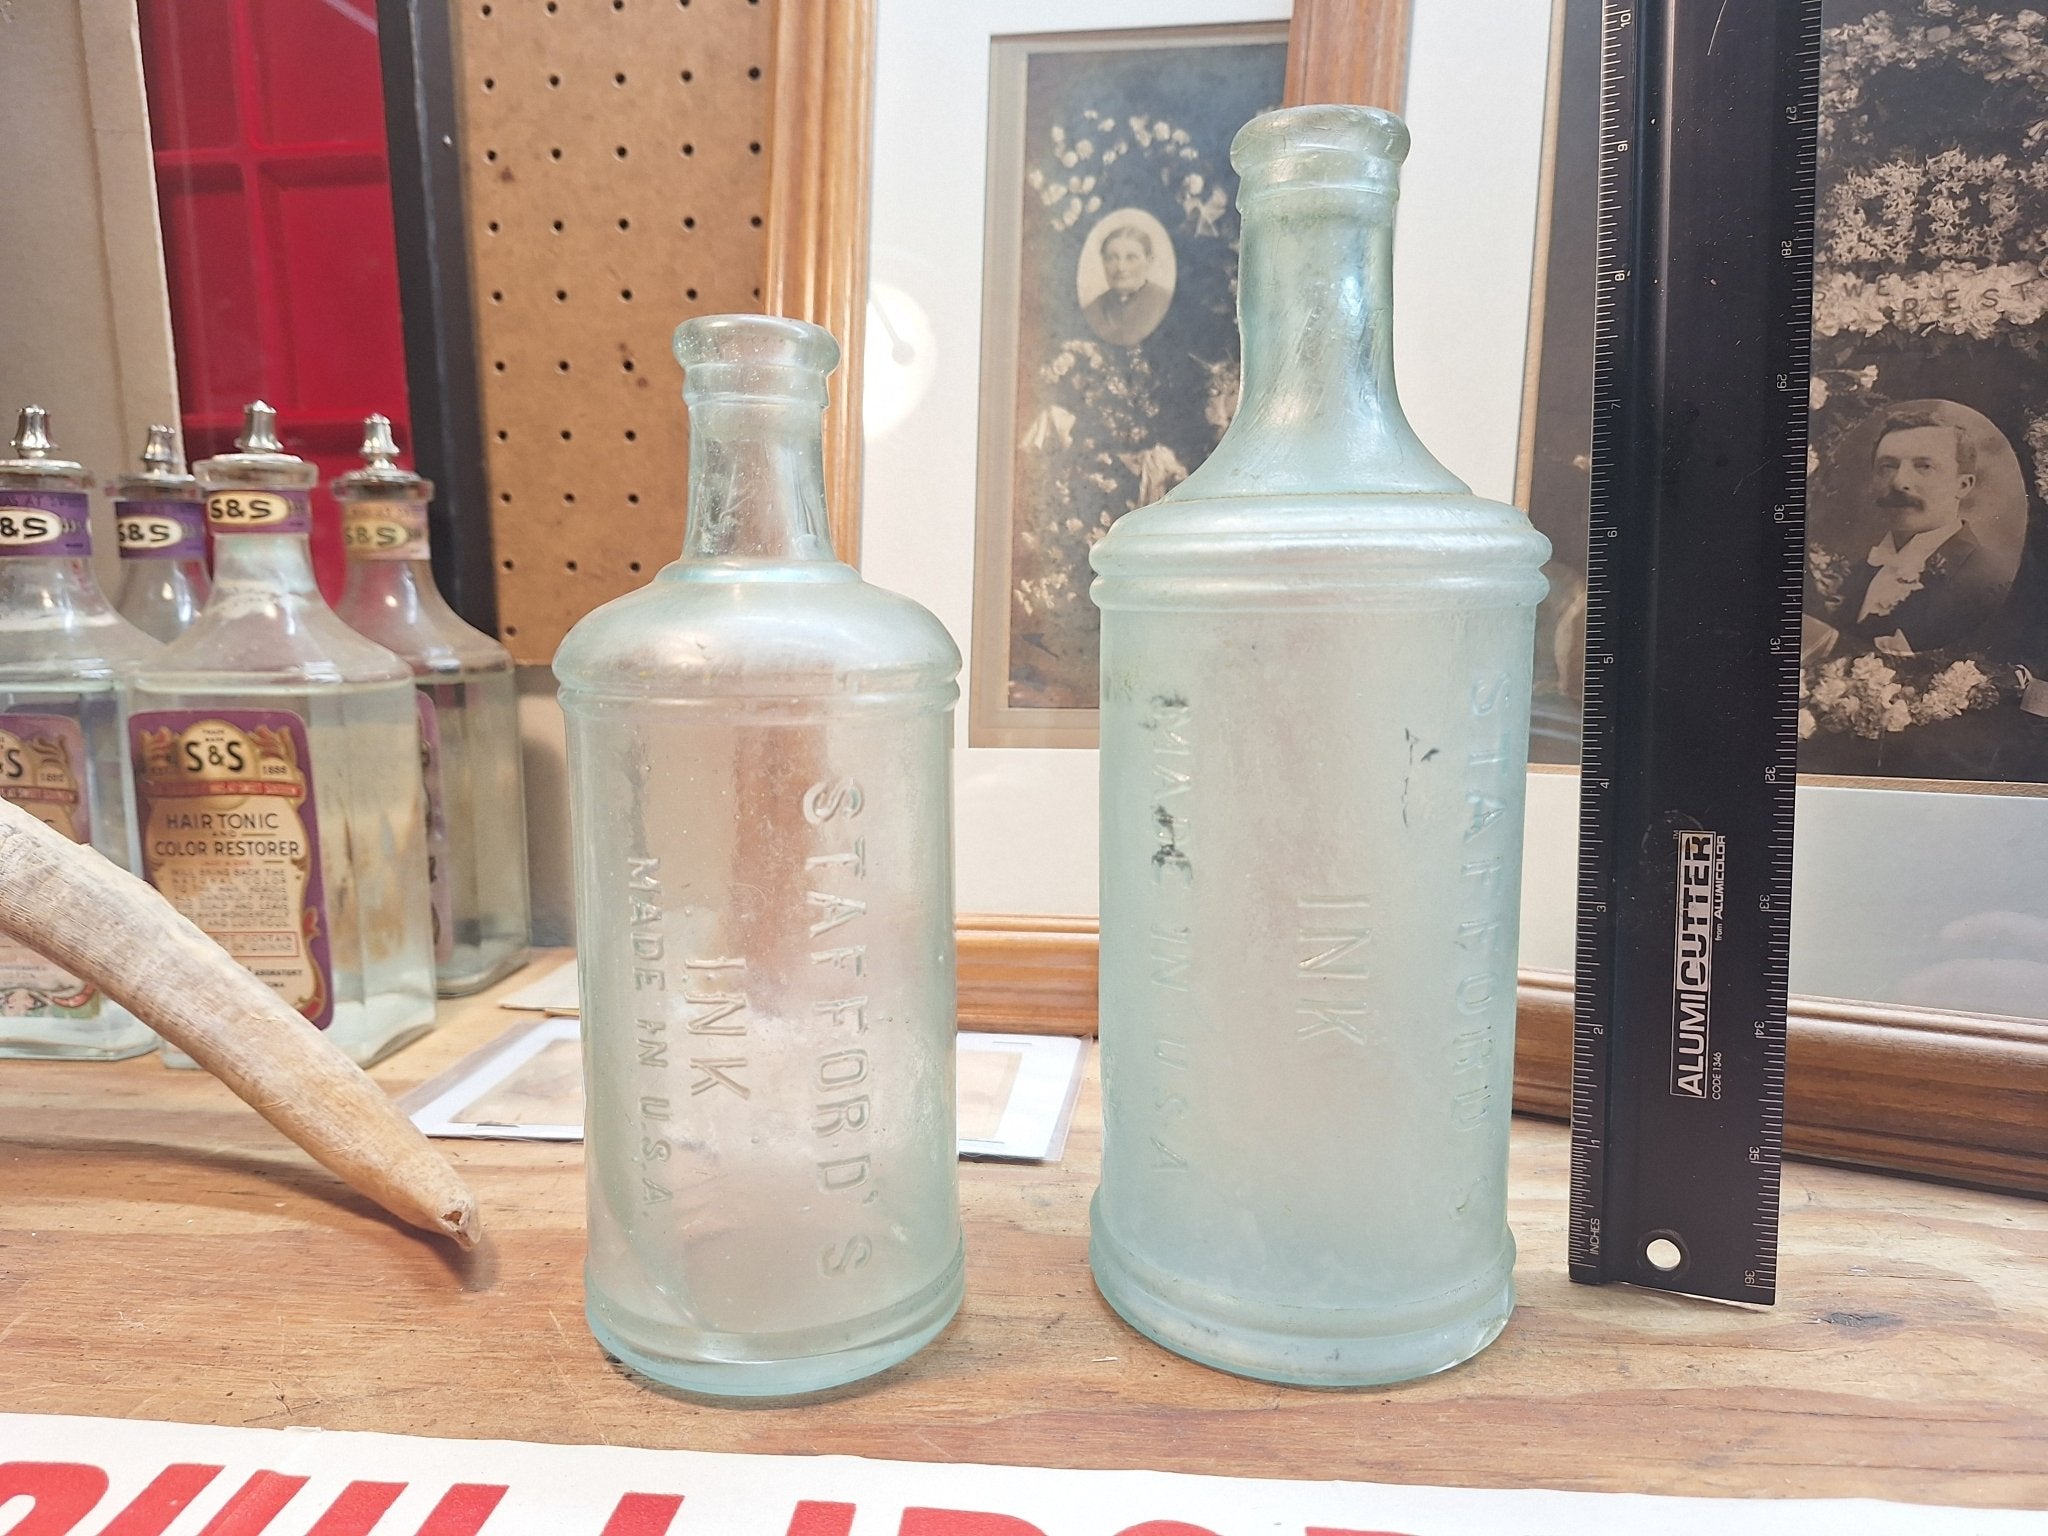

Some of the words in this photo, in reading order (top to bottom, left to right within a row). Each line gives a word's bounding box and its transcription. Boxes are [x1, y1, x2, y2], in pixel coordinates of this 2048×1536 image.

[1620, 12, 1632, 28] 10
[1785, 104, 1797, 122] 27
[1617, 141, 1628, 153] 9
[1780, 240, 1792, 258] 28
[1614, 269, 1625, 282] 8
[1902, 278, 2038, 318] REST
[1775, 372, 1787, 389] 29
[1611, 399, 1621, 410] 7
[210, 498, 272, 520] S&S
[1773, 503, 1784, 522] 30
[1607, 528, 1618, 539] 6
[1769, 637, 1782, 653] 31
[1603, 654, 1614, 665] 5
[1765, 765, 1776, 783] 32
[1600, 778, 1610, 790] 4
[166, 814, 213, 830] HAIR
[217, 813, 280, 830] TONIC
[154, 841, 208, 857] COLOR
[214, 841, 300, 856] RESTORER
[233, 868, 260, 877] BACK
[1714, 835, 1727, 920] ALUMICOLOR
[1596, 903, 1607, 914] 3
[1759, 893, 1770, 911] 33
[626, 857, 665, 991] MADE
[1715, 923, 1723, 942] from
[1296, 893, 1372, 1046] INK
[684, 957, 750, 1100] INK
[803, 778, 875, 1280] STAFFORD'S
[1593, 1025, 1603, 1035] 2
[1753, 1020, 1765, 1038] 34
[635, 1017, 668, 1068] IN
[1712, 1051, 1722, 1071] 1346
[1712, 1073, 1722, 1100] CODE
[1590, 1137, 1600, 1147] 1
[1748, 1145, 1760, 1163] 35
[1589, 1217, 1600, 1256] INCHES
[1743, 1269, 1755, 1287] 36
